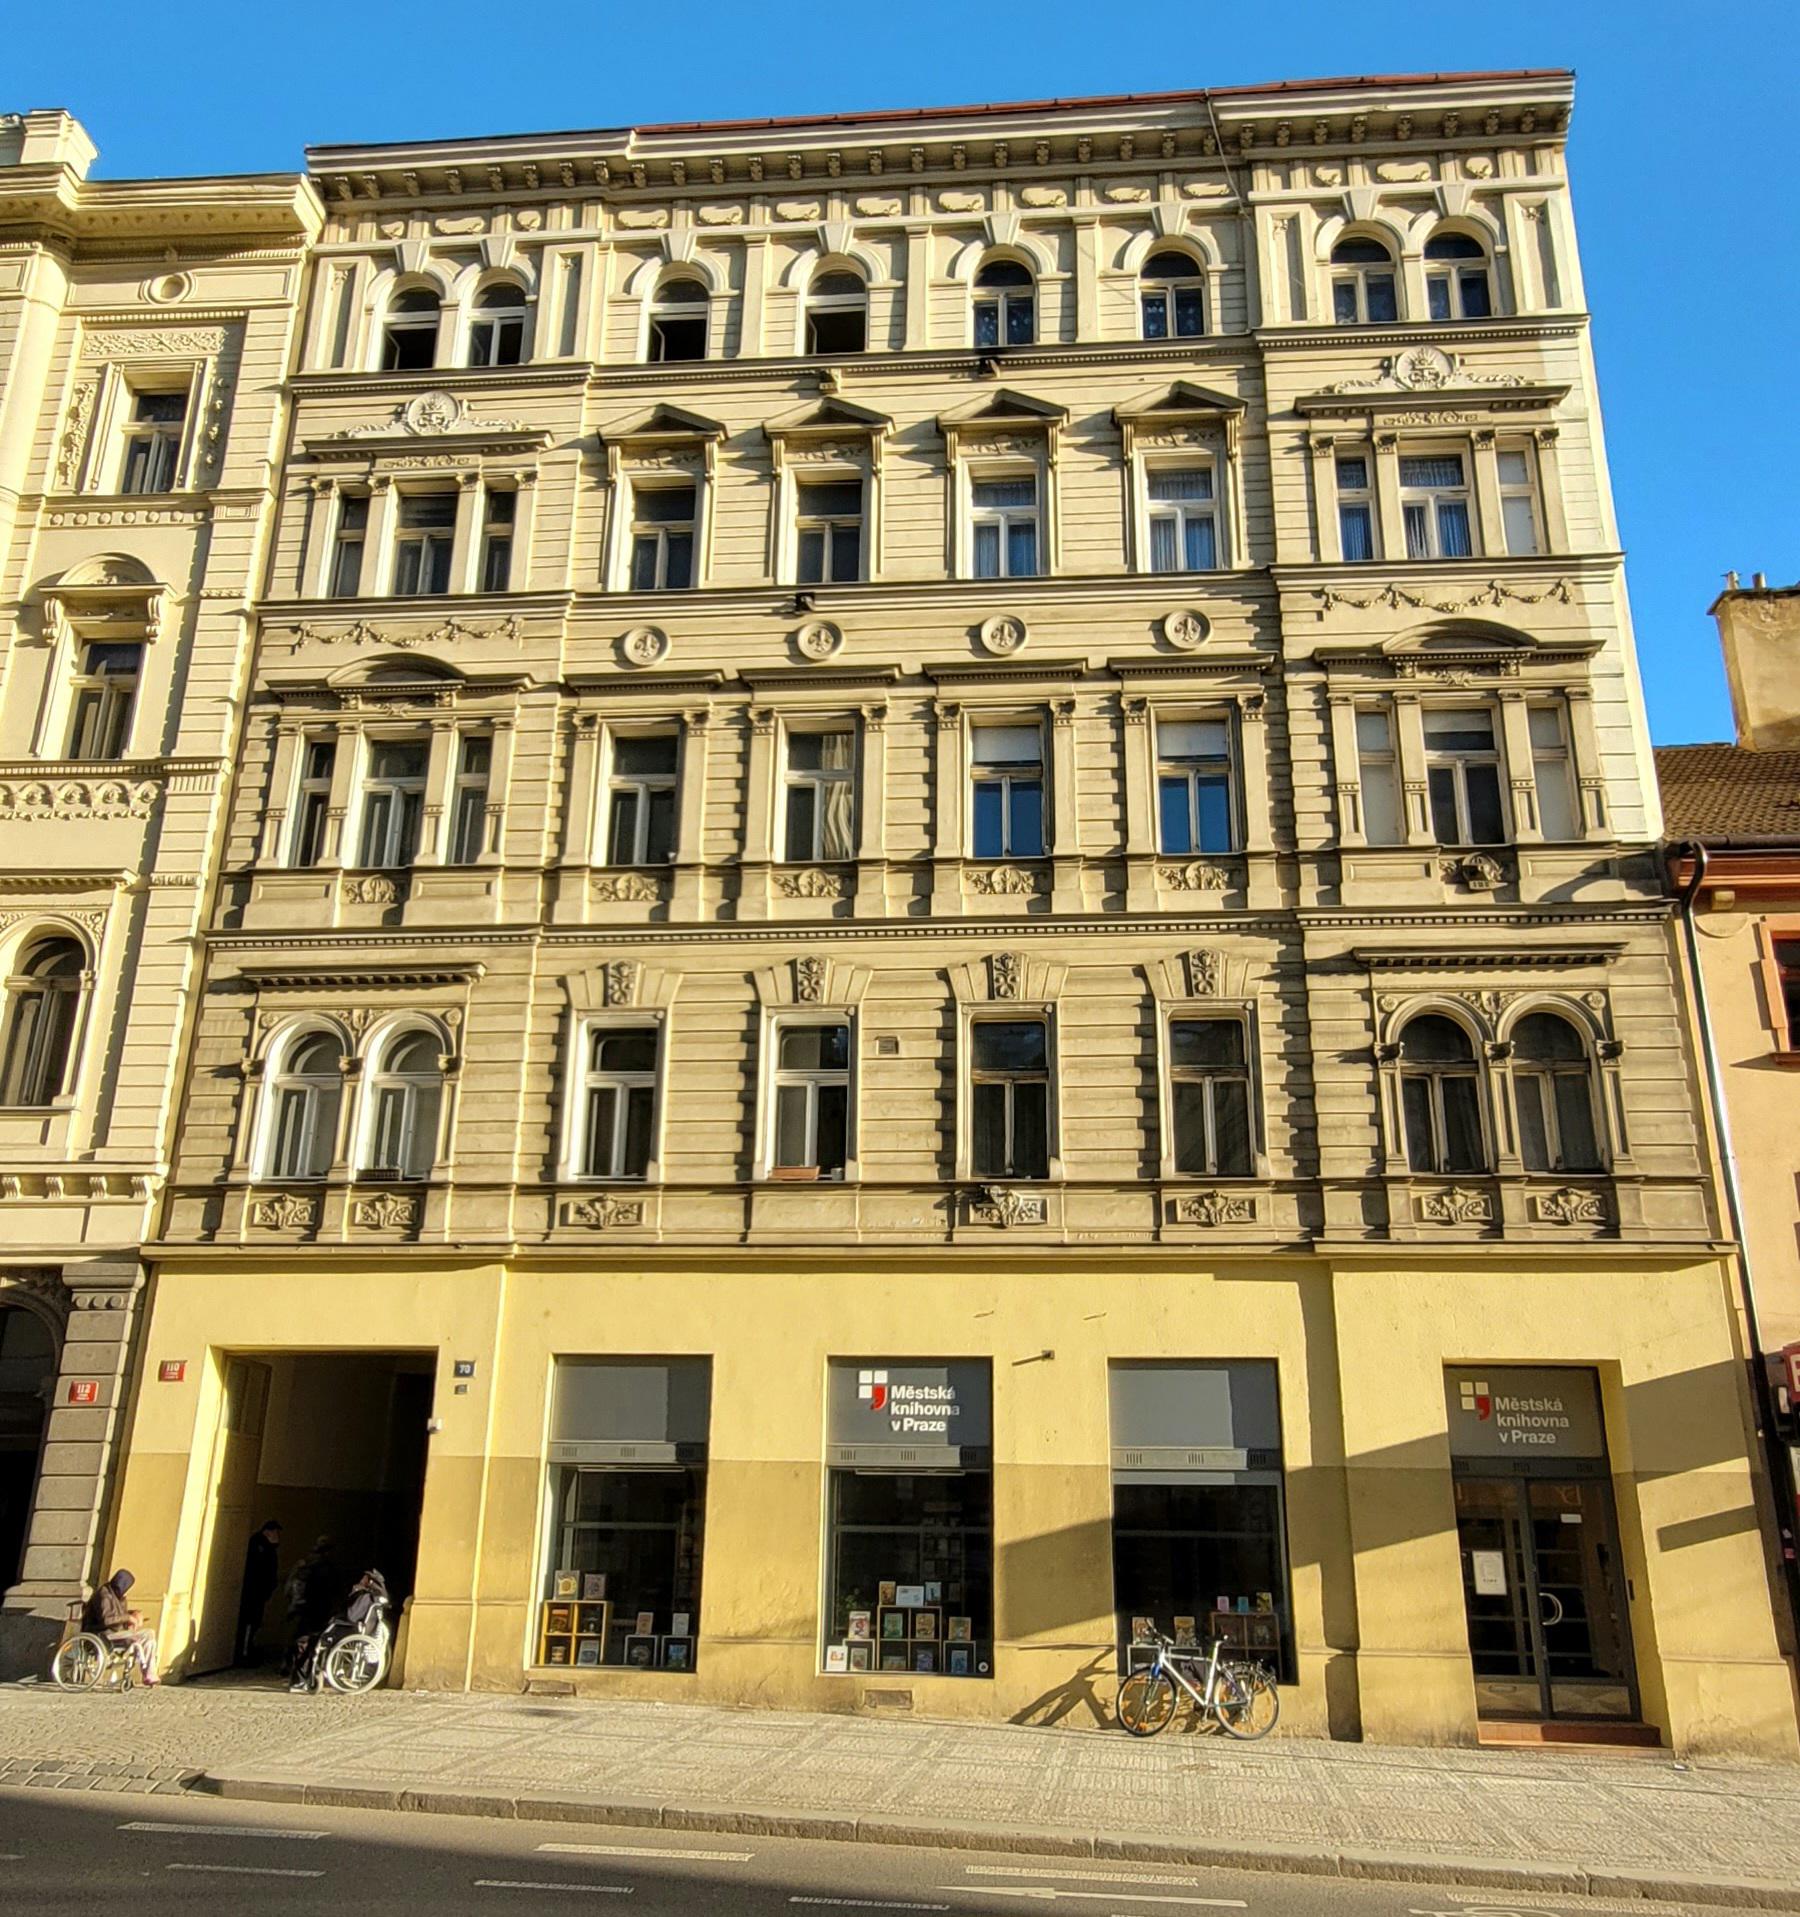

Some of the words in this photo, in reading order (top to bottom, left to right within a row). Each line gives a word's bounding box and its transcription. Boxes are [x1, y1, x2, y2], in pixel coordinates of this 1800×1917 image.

[166, 1363, 180, 1372] 110
[77, 1384, 91, 1393] 112
[890, 1384, 956, 1400] Městská
[890, 1401, 960, 1416] knihovna
[1495, 1396, 1563, 1412] Městská
[891, 1419, 901, 1432] v
[903, 1417, 947, 1432] Praze
[1496, 1412, 1570, 1428] knihovna
[1498, 1431, 1509, 1444] v
[1511, 1429, 1557, 1444] Praze
